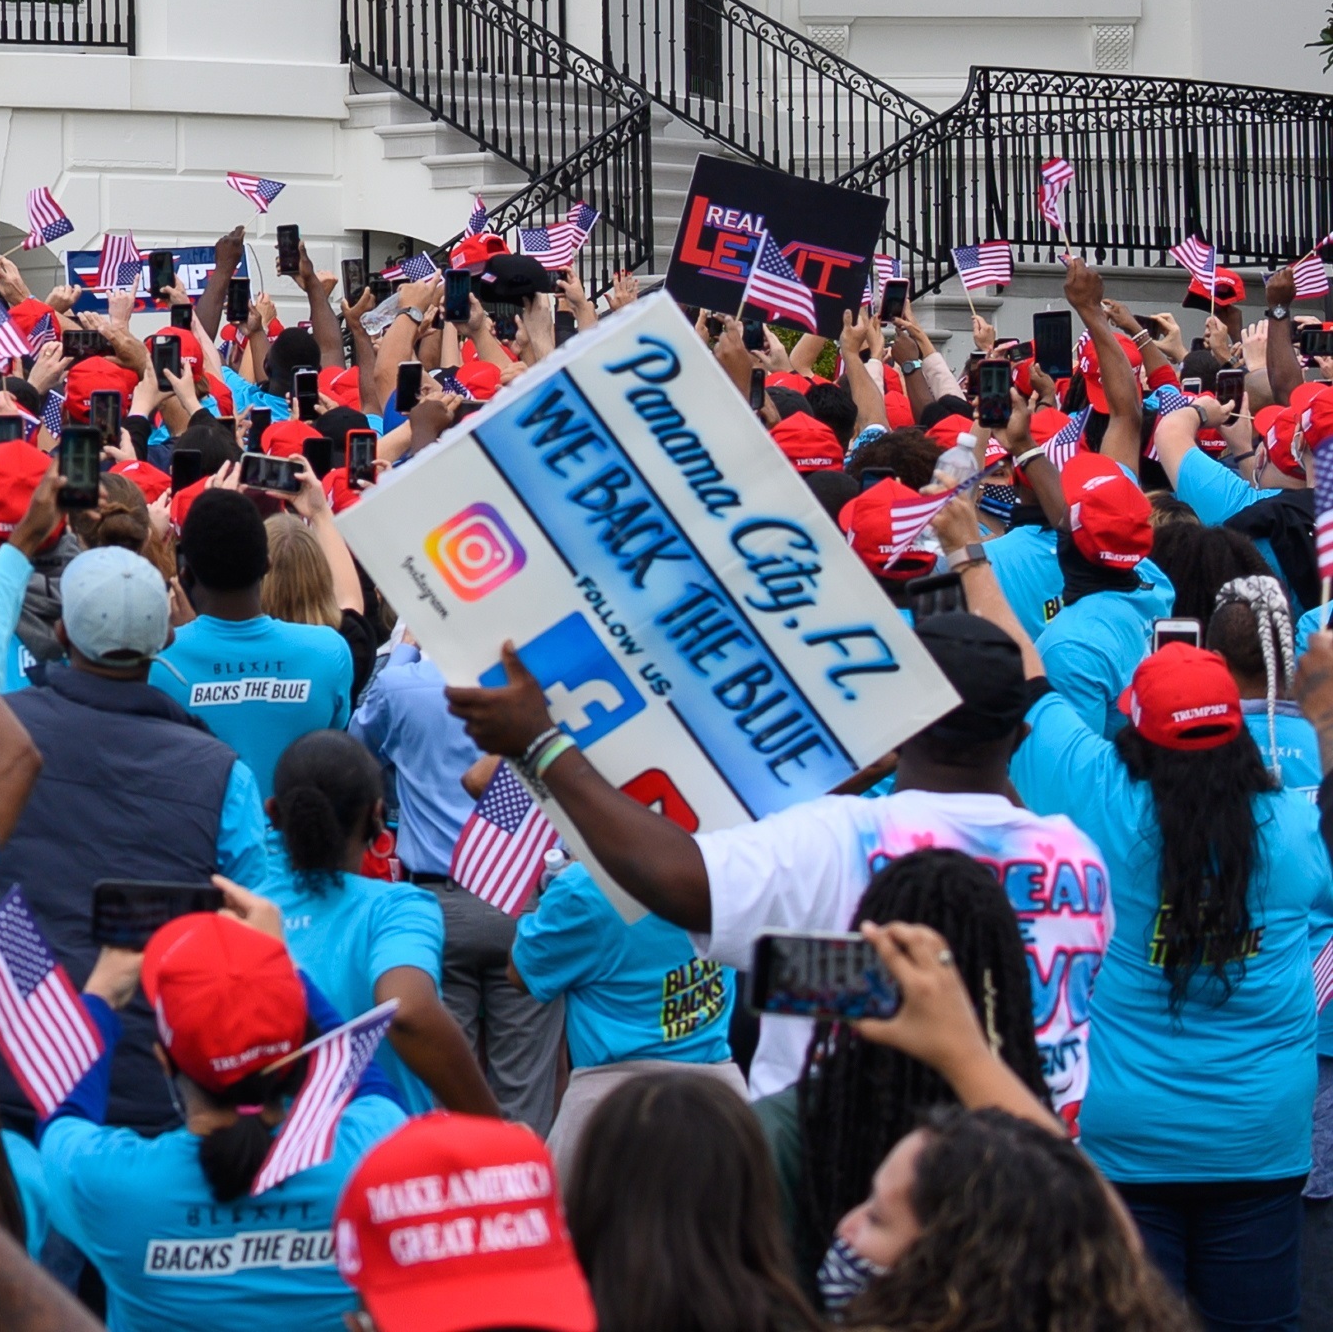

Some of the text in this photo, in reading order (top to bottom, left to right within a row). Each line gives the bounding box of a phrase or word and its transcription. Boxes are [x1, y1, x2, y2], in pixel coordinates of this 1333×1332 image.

[706, 206, 767, 234] REAL
[679, 195, 853, 299] LEIT
[604, 334, 742, 518] Panama
[516, 389, 833, 787] WE BACK THE BLUE
[576, 576, 672, 696] FOLLOW US
[193, 681, 308, 702] BACKS THE BLUE
[664, 971, 724, 1025] BACKS
[366, 1179, 442, 1224] MAKE
[150, 1233, 335, 1271] BACKS THE BLU
[389, 1220, 474, 1266] GREAT
